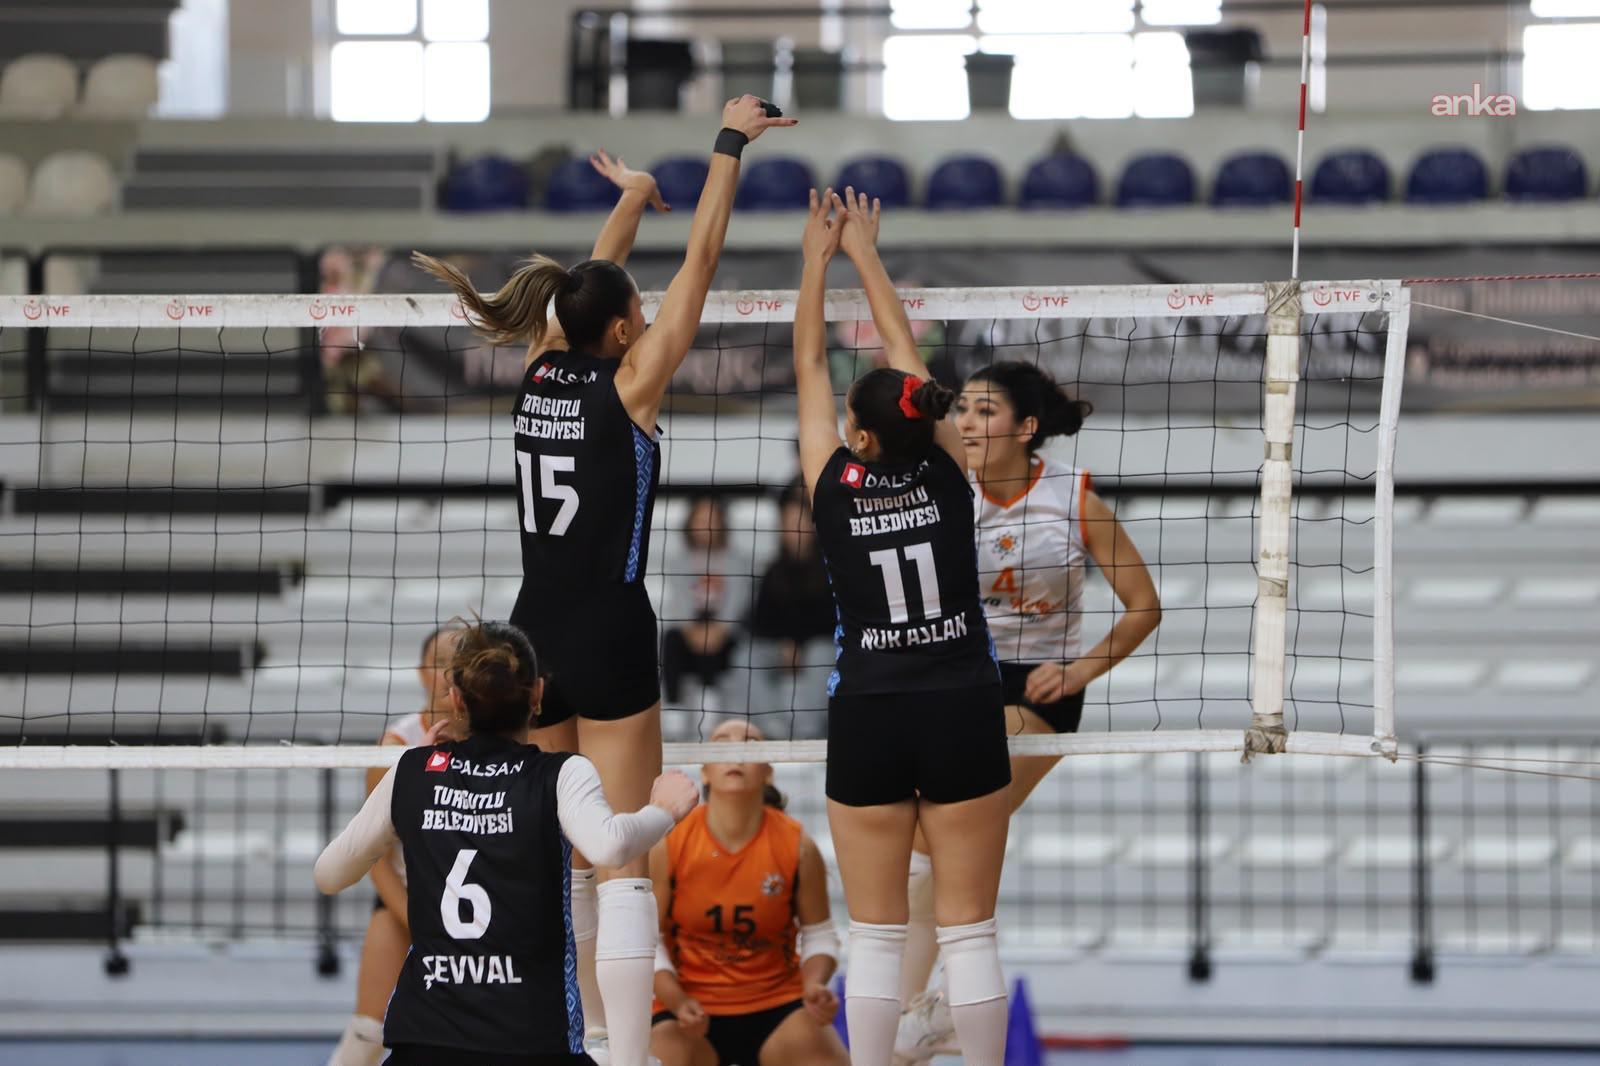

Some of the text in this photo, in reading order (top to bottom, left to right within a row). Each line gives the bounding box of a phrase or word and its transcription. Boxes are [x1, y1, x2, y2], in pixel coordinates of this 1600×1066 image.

[756, 300, 782, 311] TVF
[1042, 296, 1069, 307] TVF
[1188, 294, 1214, 305] TVF
[1334, 290, 1361, 301] TVF
[46, 305, 70, 316] TVF
[187, 305, 213, 316] TVF
[330, 305, 356, 316] TVF
[516, 449, 580, 536] 15
[854, 485, 929, 514] TURGUTLU
[849, 499, 941, 536] BELEDİYESİ
[869, 541, 942, 624] 11
[991, 566, 1018, 593] 4
[433, 785, 506, 810] TURGUTLU
[421, 807, 513, 835] BELEDİYESİ
[440, 849, 492, 939] 6
[705, 904, 757, 937] 15
[422, 955, 523, 991] ŞEVVAL
